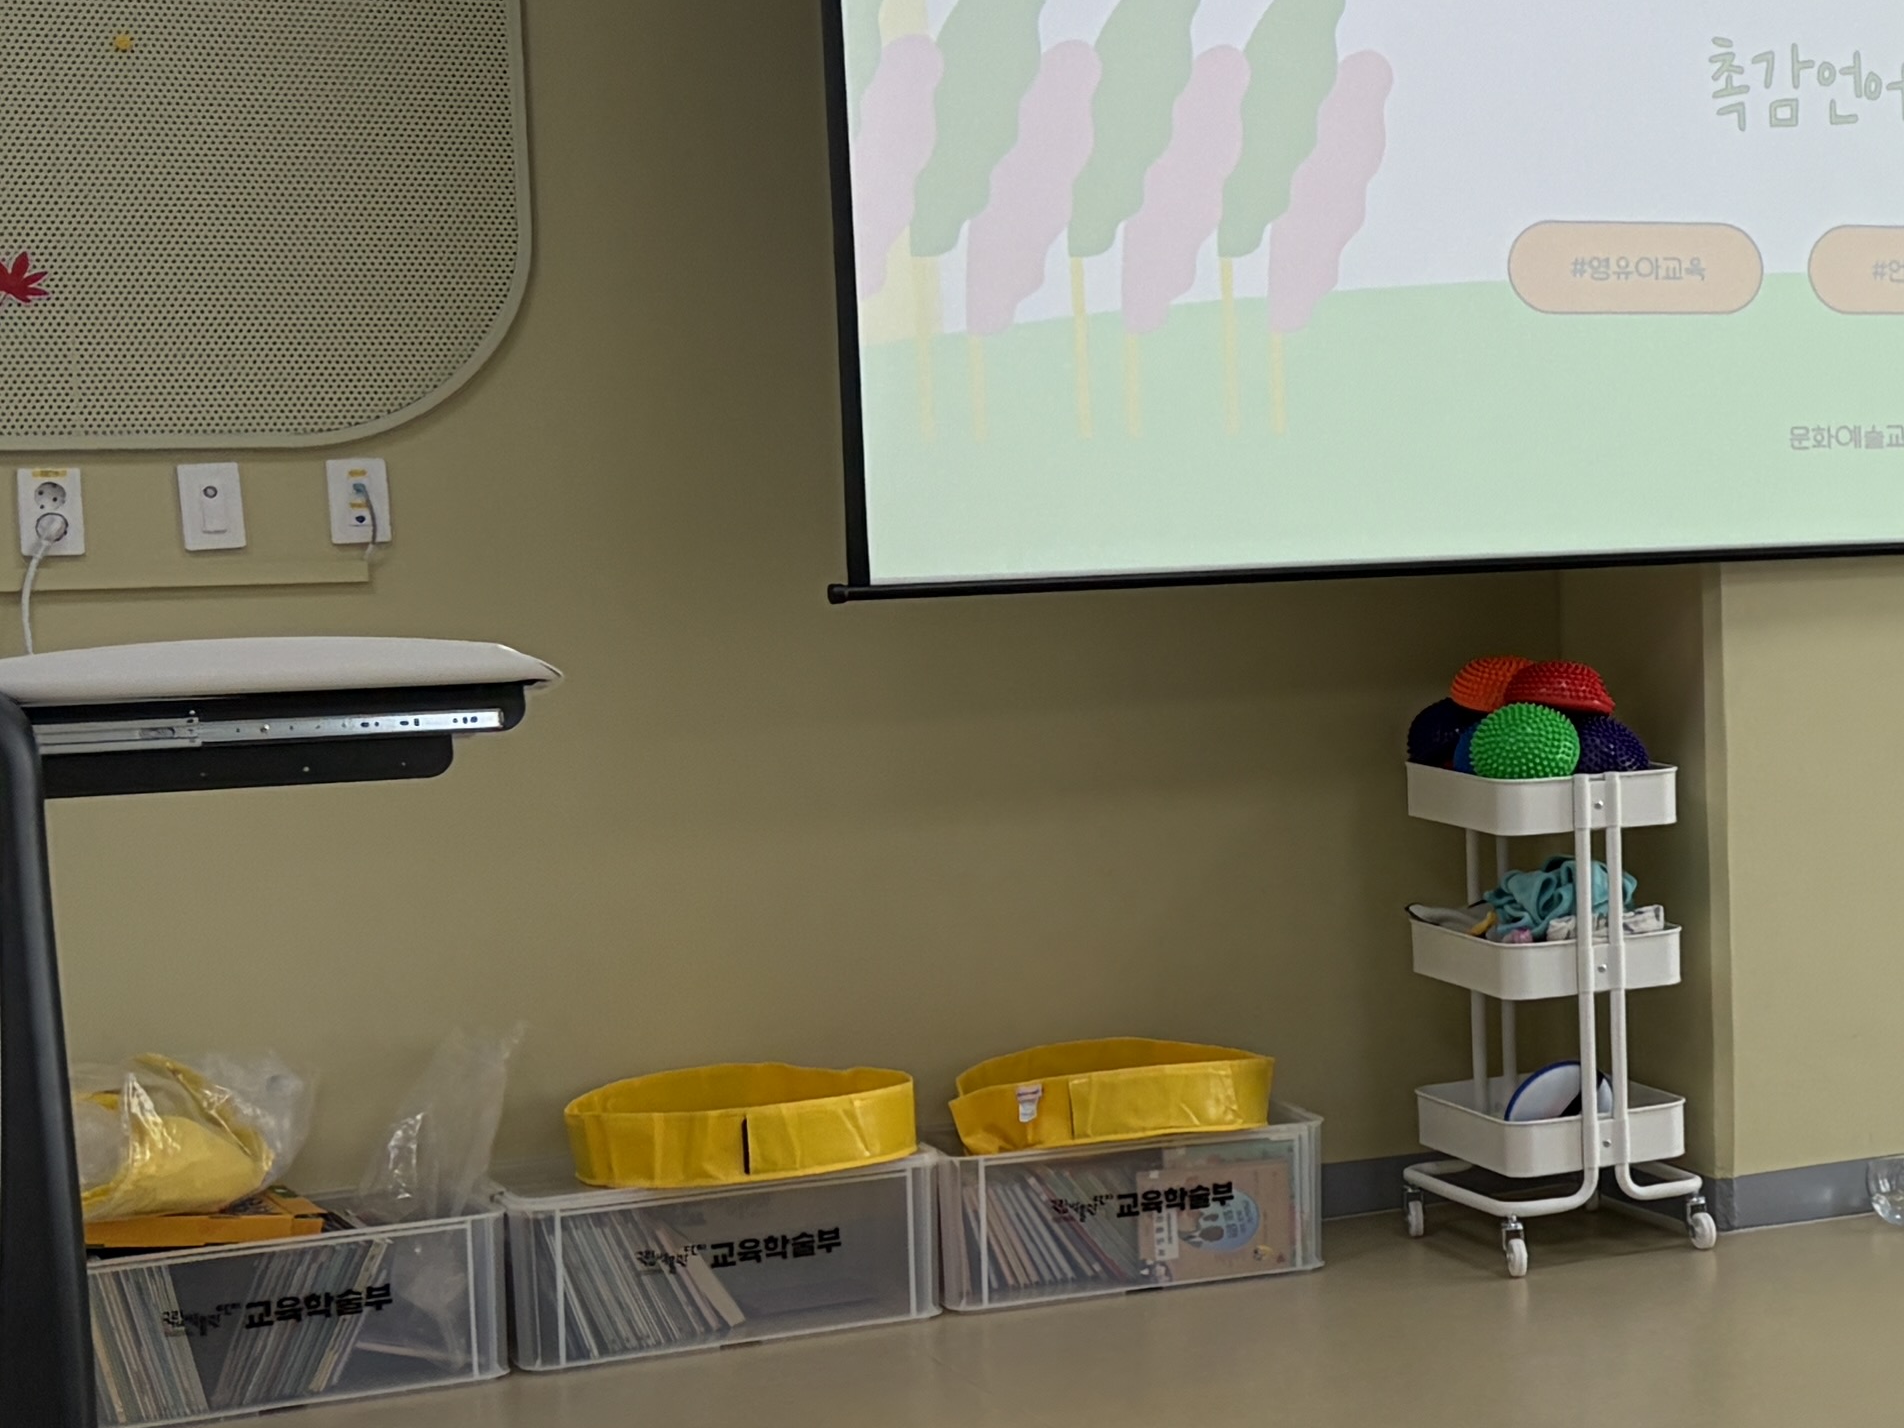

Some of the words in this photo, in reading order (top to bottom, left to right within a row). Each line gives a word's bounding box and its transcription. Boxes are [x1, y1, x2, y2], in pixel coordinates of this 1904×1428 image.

[1570, 256, 1707, 282] #영유아교육
[1116, 1181, 1235, 1218] 교육학술부
[710, 1227, 842, 1269] 교육학술부
[245, 1283, 393, 1329] 교육학술부
